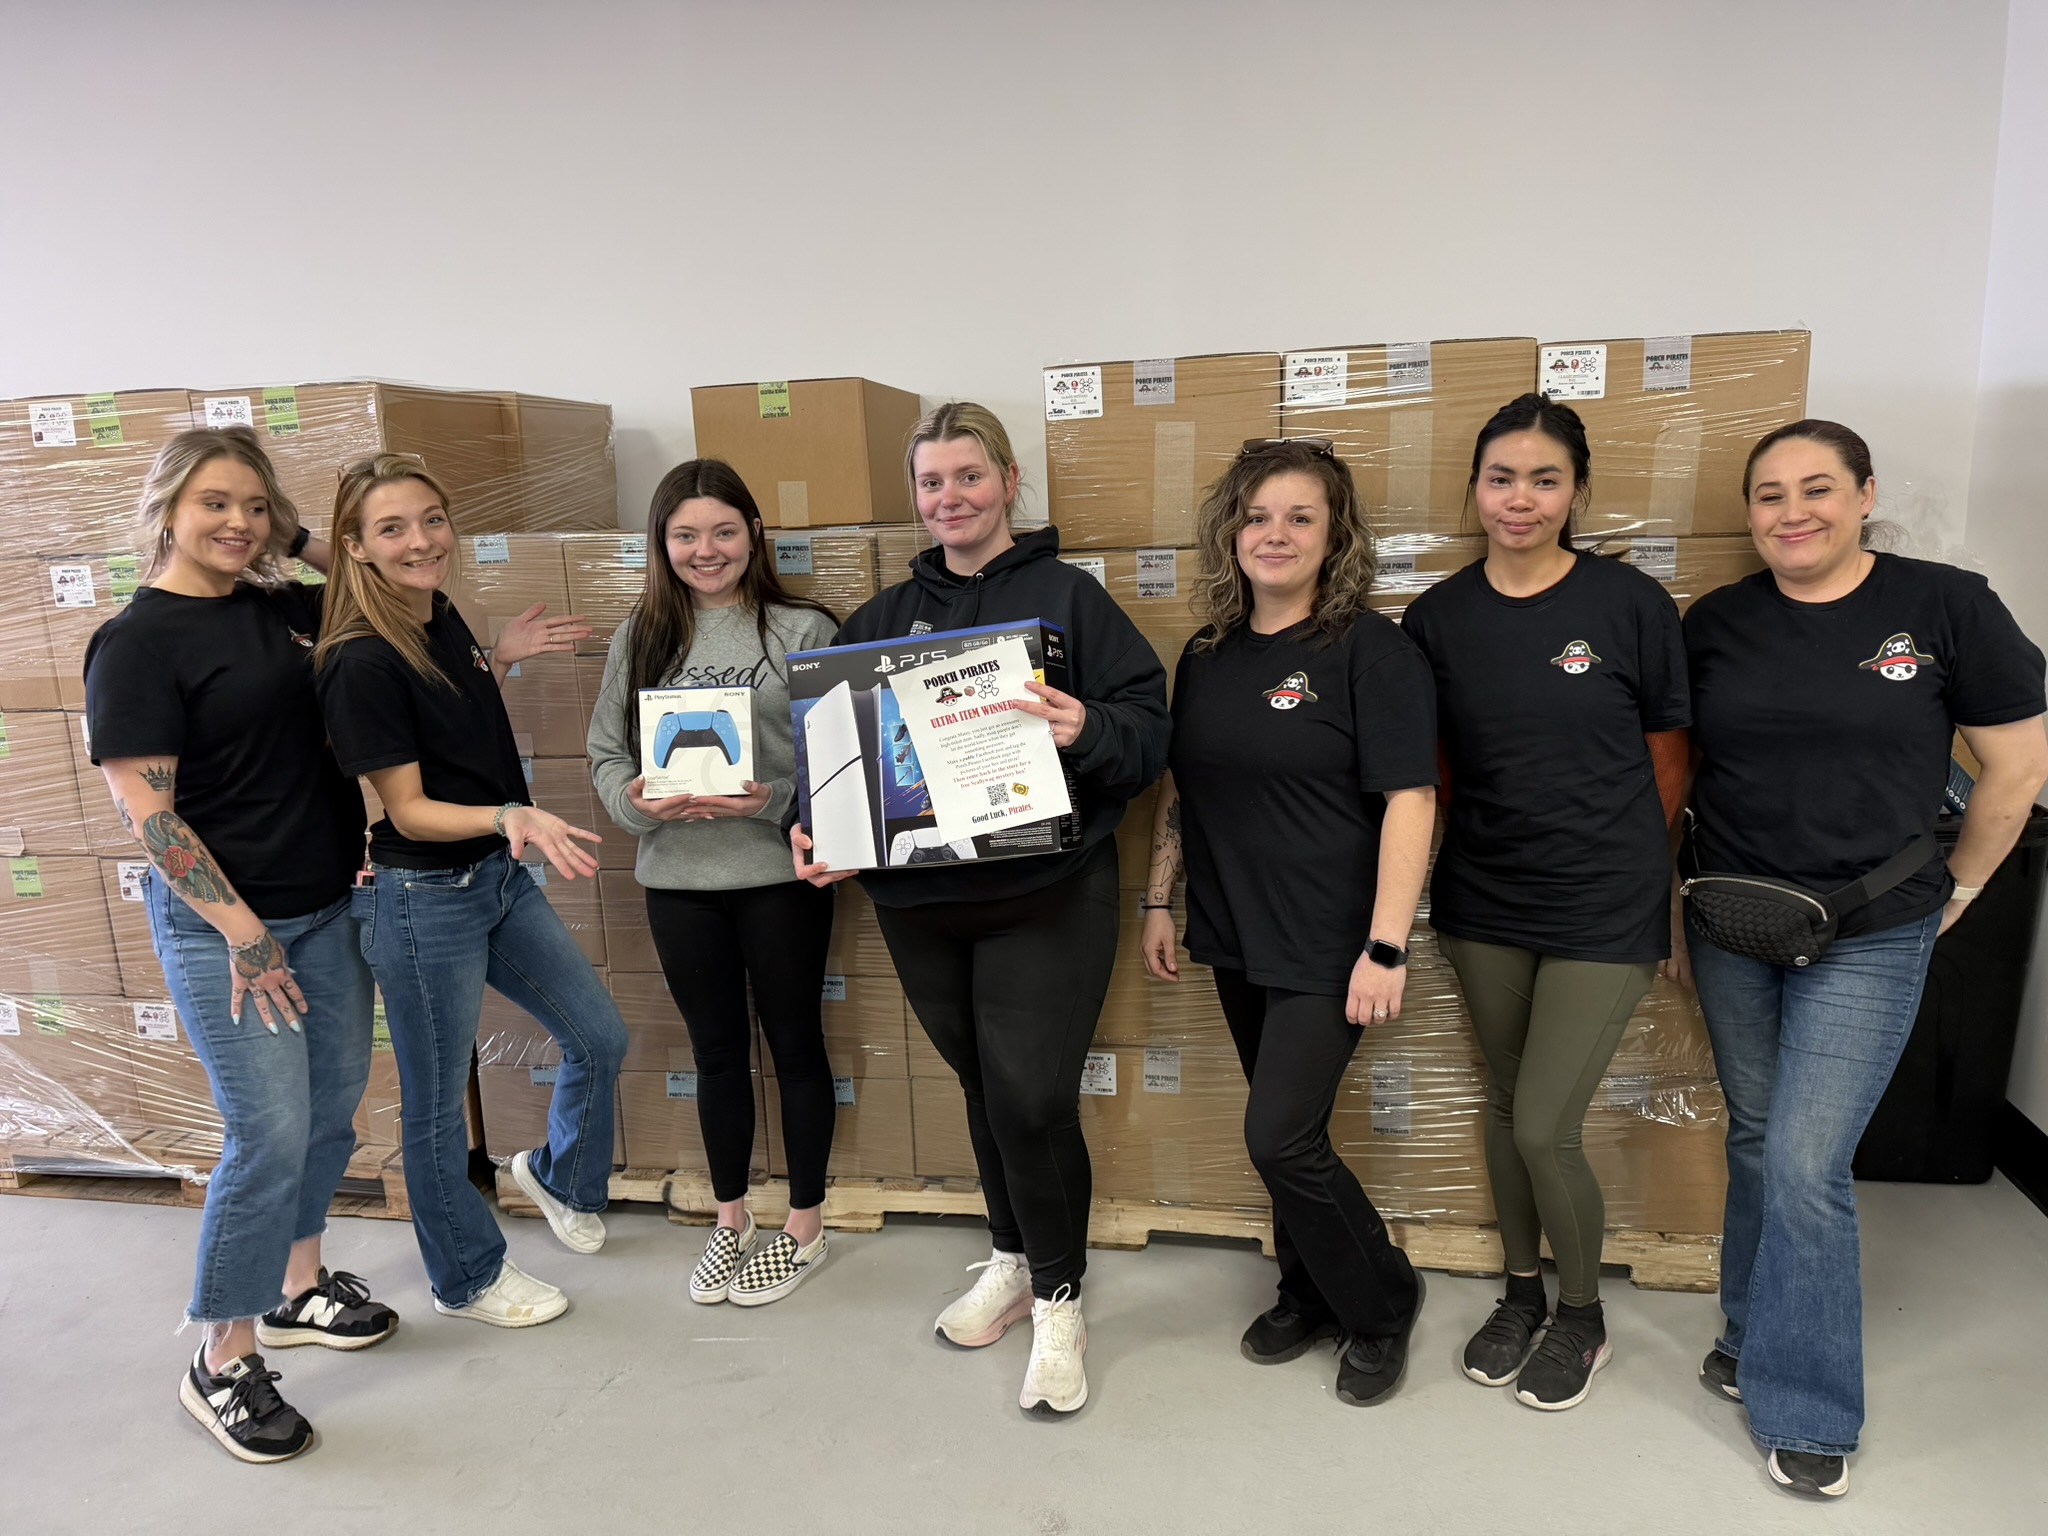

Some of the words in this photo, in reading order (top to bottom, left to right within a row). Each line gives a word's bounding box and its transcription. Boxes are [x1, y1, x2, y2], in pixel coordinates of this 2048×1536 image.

[1389, 362, 1407, 370] PORCH
[1645, 354, 1665, 362] PORCH
[1666, 353, 1689, 361] PIRATES
[1136, 377, 1152, 385] PORCH
[792, 661, 821, 672] SONY
[899, 649, 948, 668] PS5
[663, 656, 768, 691] essed
[923, 671, 959, 690] PORCH
[959, 659, 1001, 679] PIRATES
[930, 713, 958, 729] ULTRA
[959, 707, 980, 722] ITEM
[971, 813, 989, 824] Good
[989, 809, 1008, 820] Luck,
[1008, 803, 1034, 816] Pirates.
